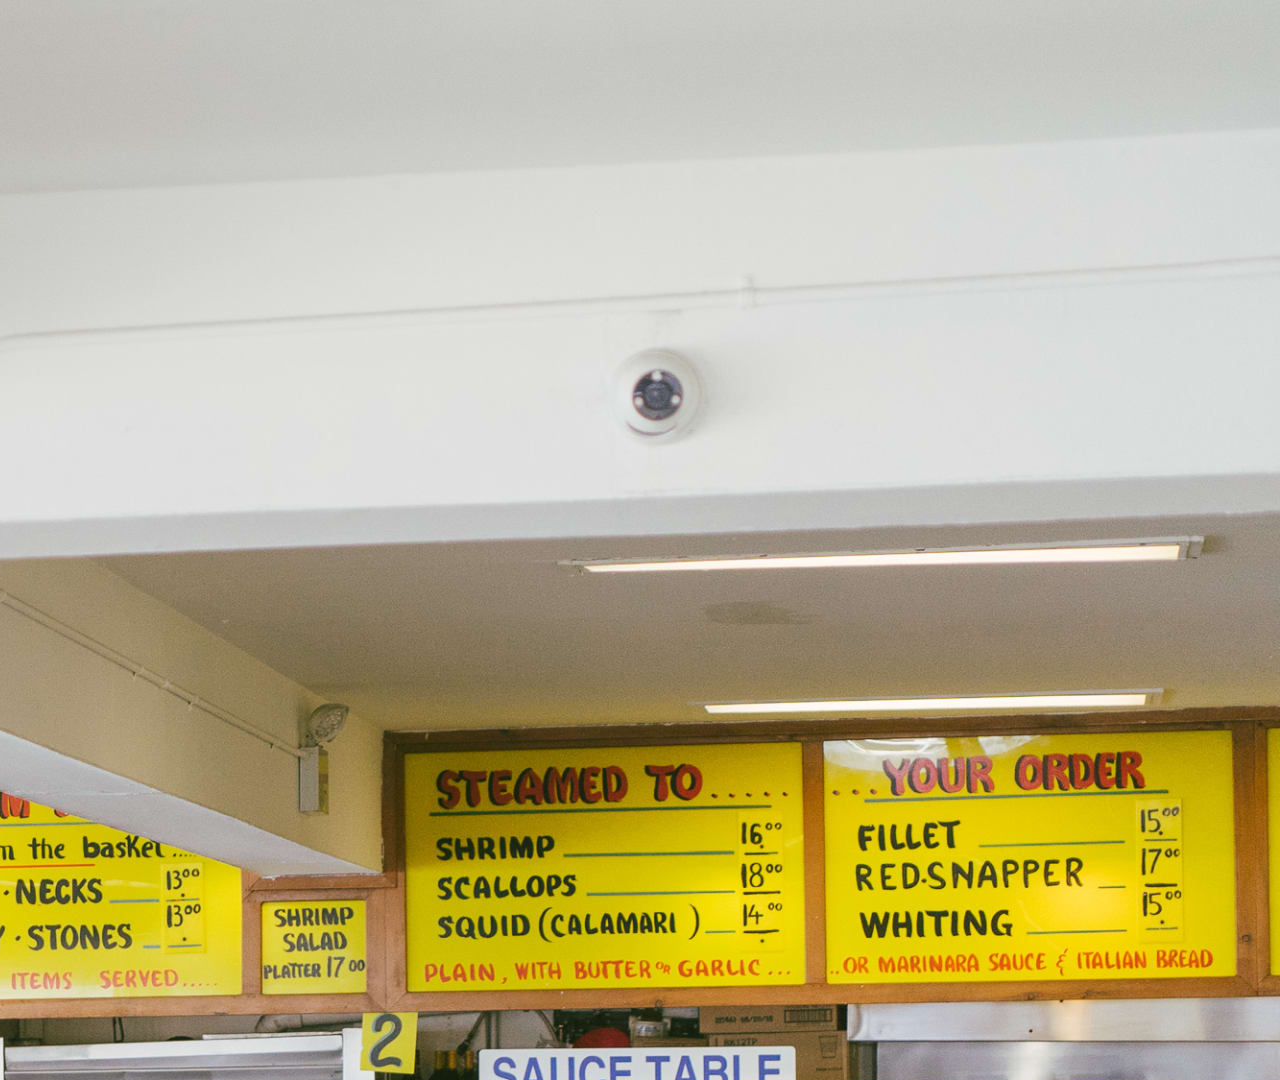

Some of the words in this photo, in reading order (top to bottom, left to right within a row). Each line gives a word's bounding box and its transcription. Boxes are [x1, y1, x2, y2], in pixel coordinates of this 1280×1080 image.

[1014, 751, 1146, 791] ORDER
[436, 764, 629, 809] STEAMED
[28, 838, 65, 859] the
[436, 835, 555, 861] SHRIMP
[857, 821, 961, 851] FILLET
[15, 878, 103, 905] NECKS
[437, 874, 576, 900] SCALLOPS
[274, 907, 354, 927] SHRIMP
[437, 913, 530, 940] SQUID
[860, 910, 1013, 939] WHITING
[27, 923, 133, 951] STONES
[283, 931, 348, 952] SALAD
[263, 962, 321, 979] PLATTER
[515, 961, 562, 980] WITH
[574, 959, 651, 980] BUTTER
[655, 961, 671, 974] OR
[879, 954, 979, 973] MARINARA
[989, 952, 1046, 972] SAUCE
[1077, 950, 1147, 970] ITALIAN
[1156, 949, 1214, 969] BREAD
[11, 971, 73, 990] ITEMS
[369, 1013, 403, 1068] 2
